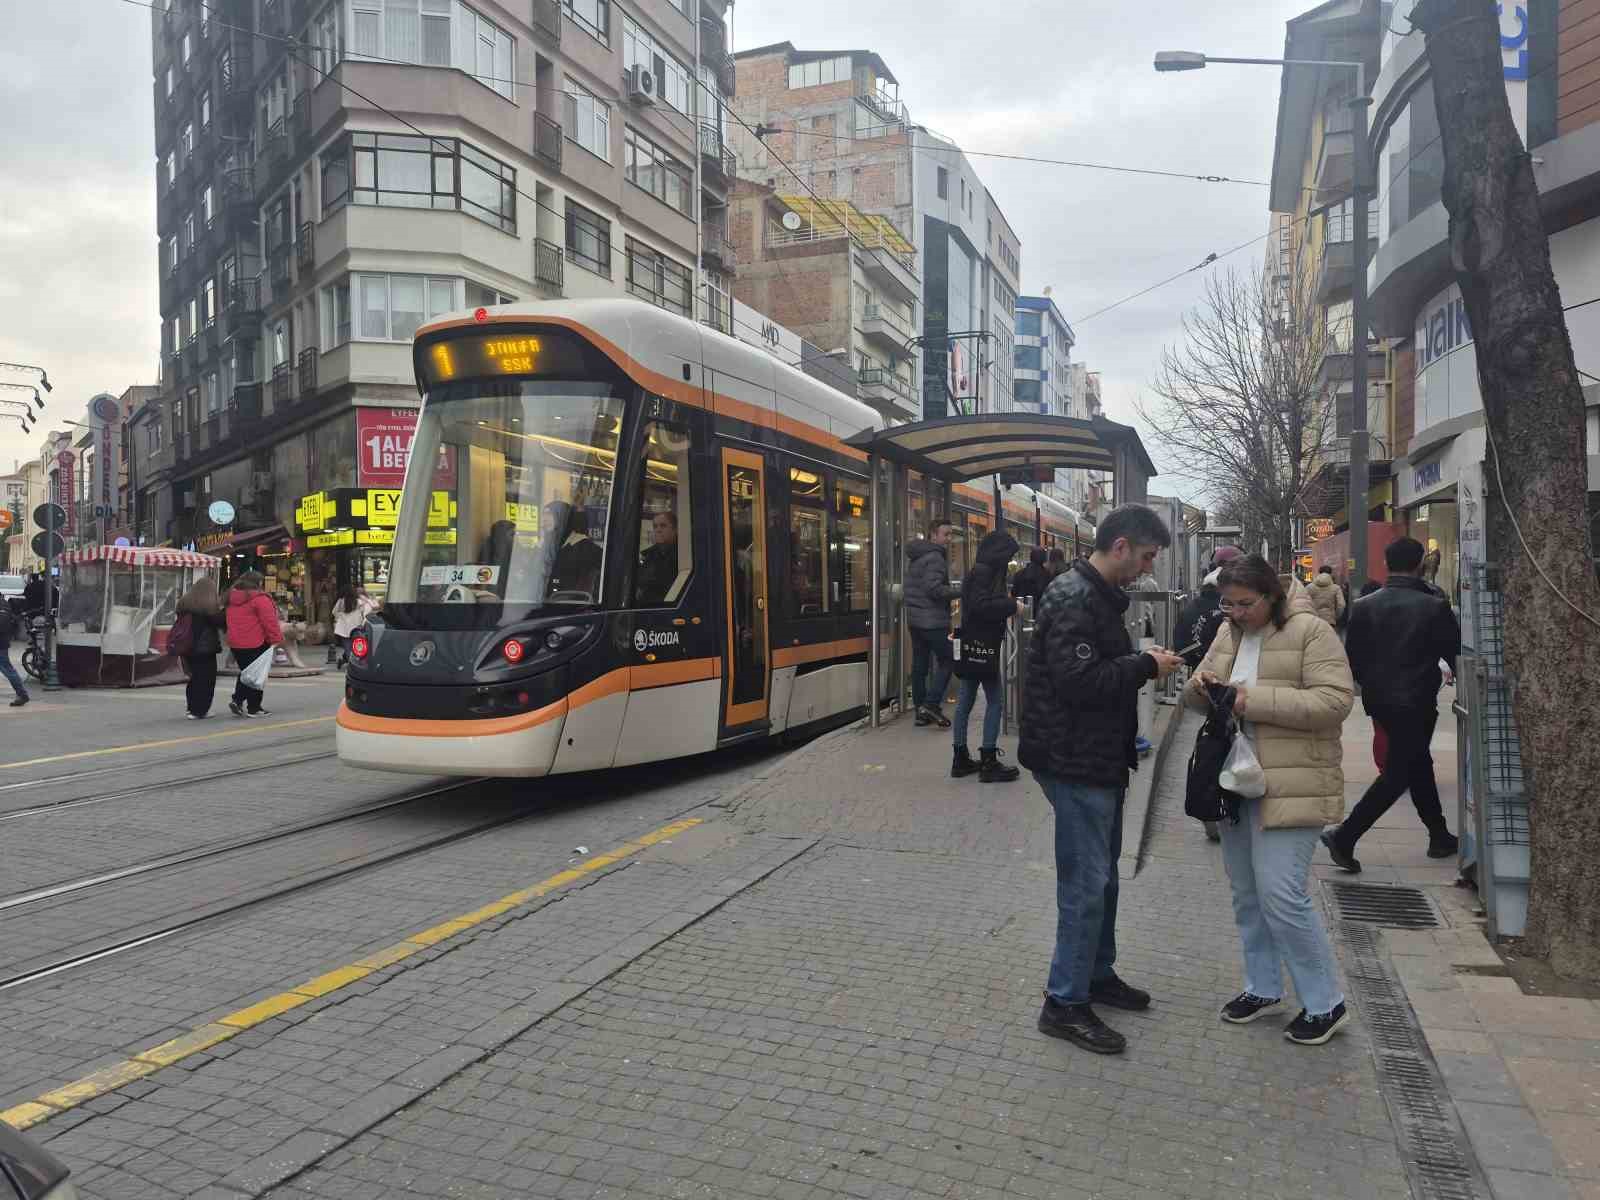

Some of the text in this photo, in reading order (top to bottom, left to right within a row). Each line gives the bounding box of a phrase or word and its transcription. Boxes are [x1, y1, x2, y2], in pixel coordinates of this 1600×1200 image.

[366, 435, 381, 468] 1
[303, 497, 319, 518] EYFEL
[375, 493, 442, 513] EYL
[451, 570, 464, 582] 34
[648, 630, 680, 647] ŠKODA
